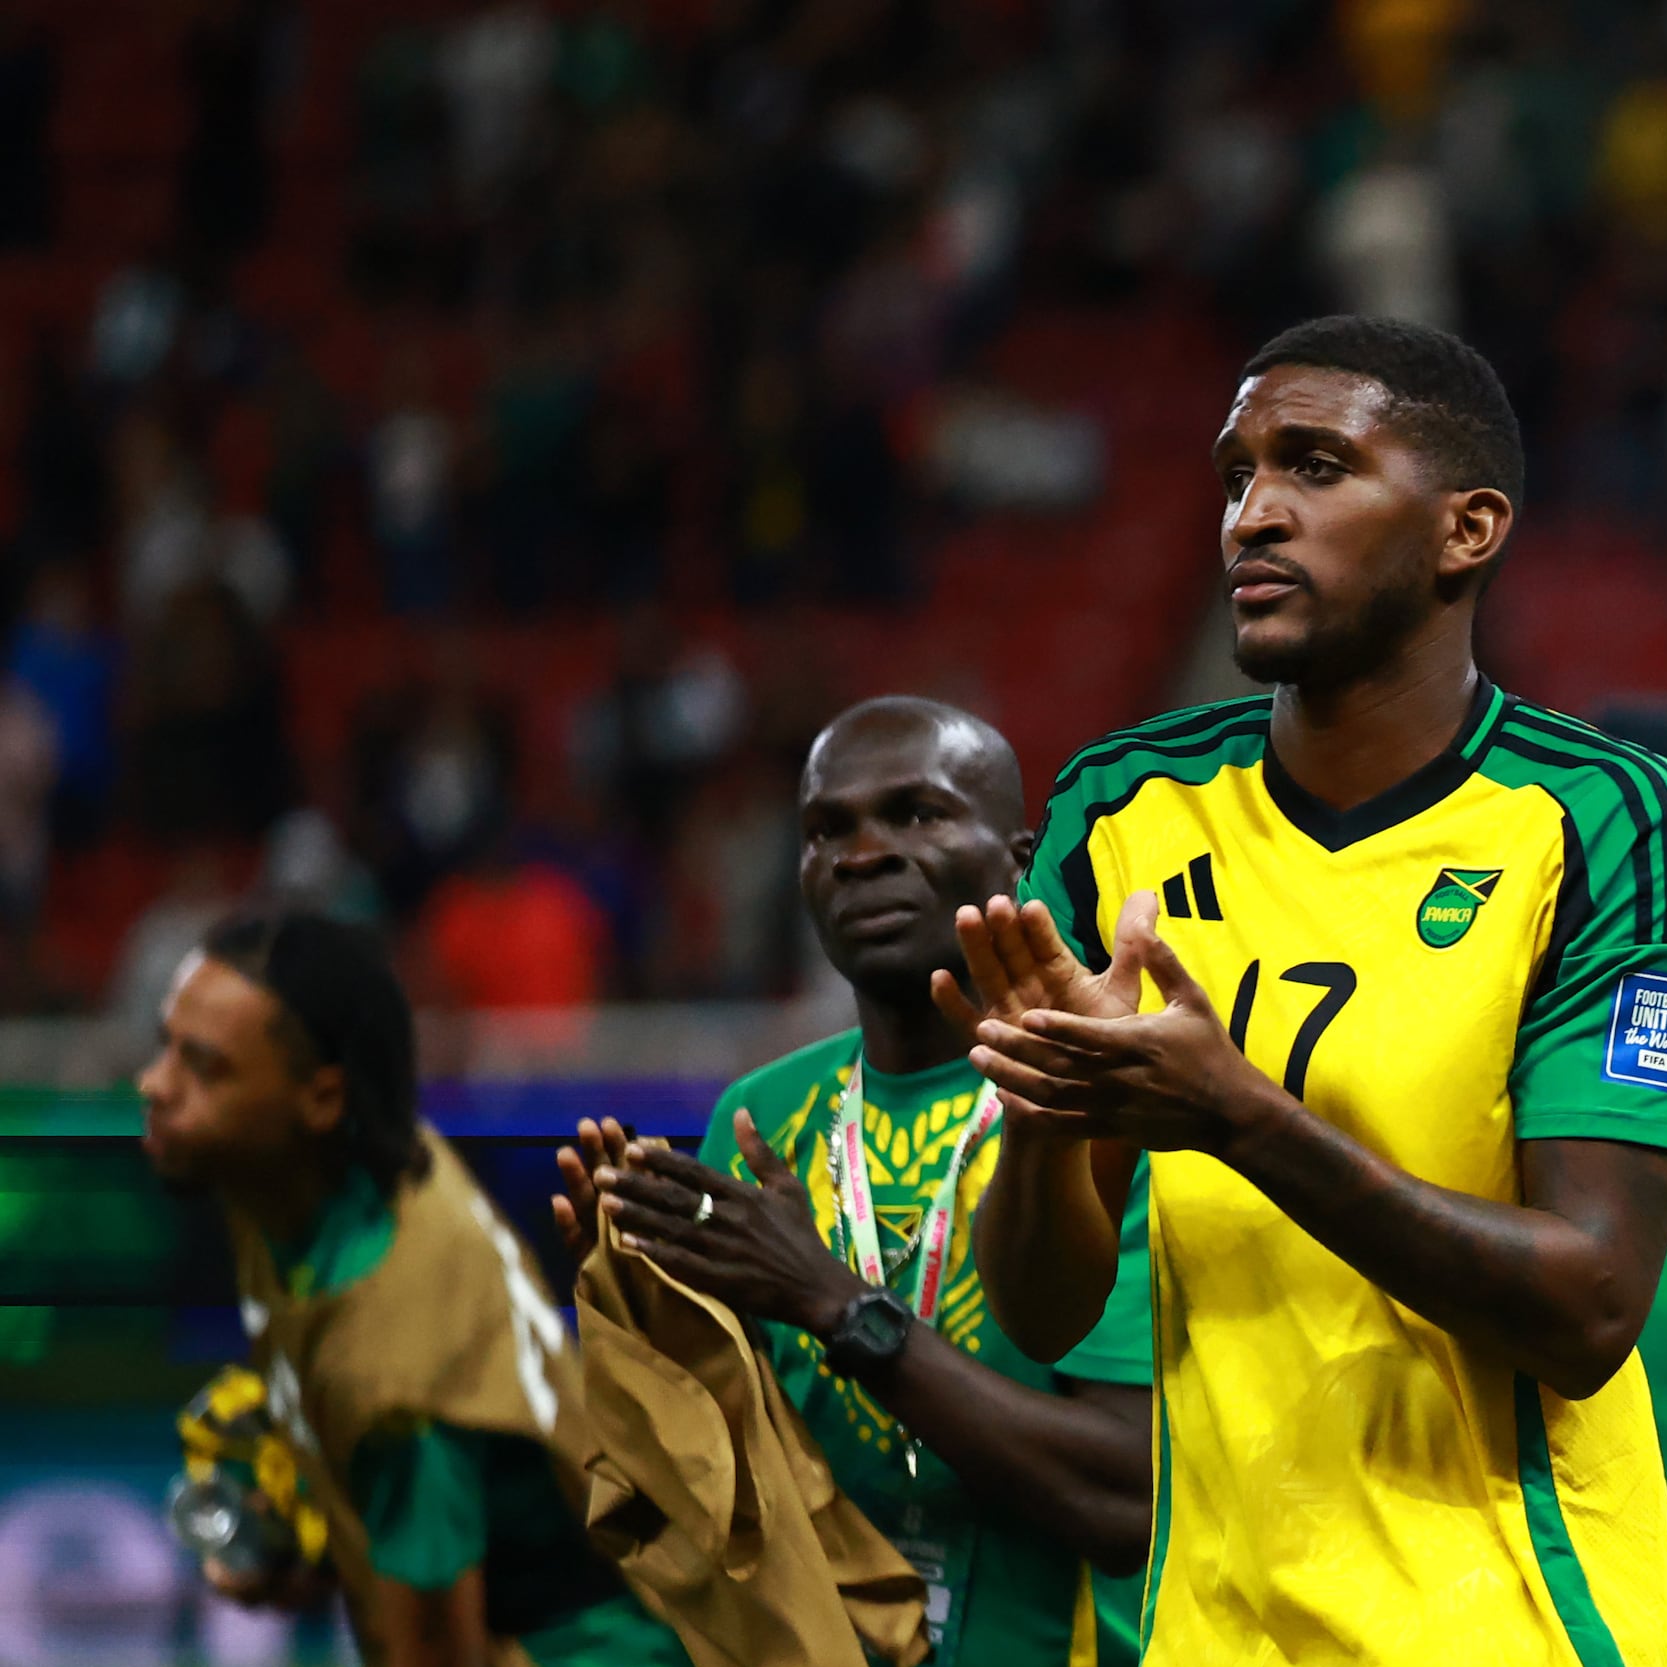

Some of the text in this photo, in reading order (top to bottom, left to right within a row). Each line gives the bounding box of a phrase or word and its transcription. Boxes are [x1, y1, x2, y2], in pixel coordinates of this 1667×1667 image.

[1421, 906, 1473, 922] JAMAICA
[1229, 959, 1357, 1103] 17
[1624, 1027, 1648, 1045] the
[1643, 1054, 1665, 1066] FIFA
